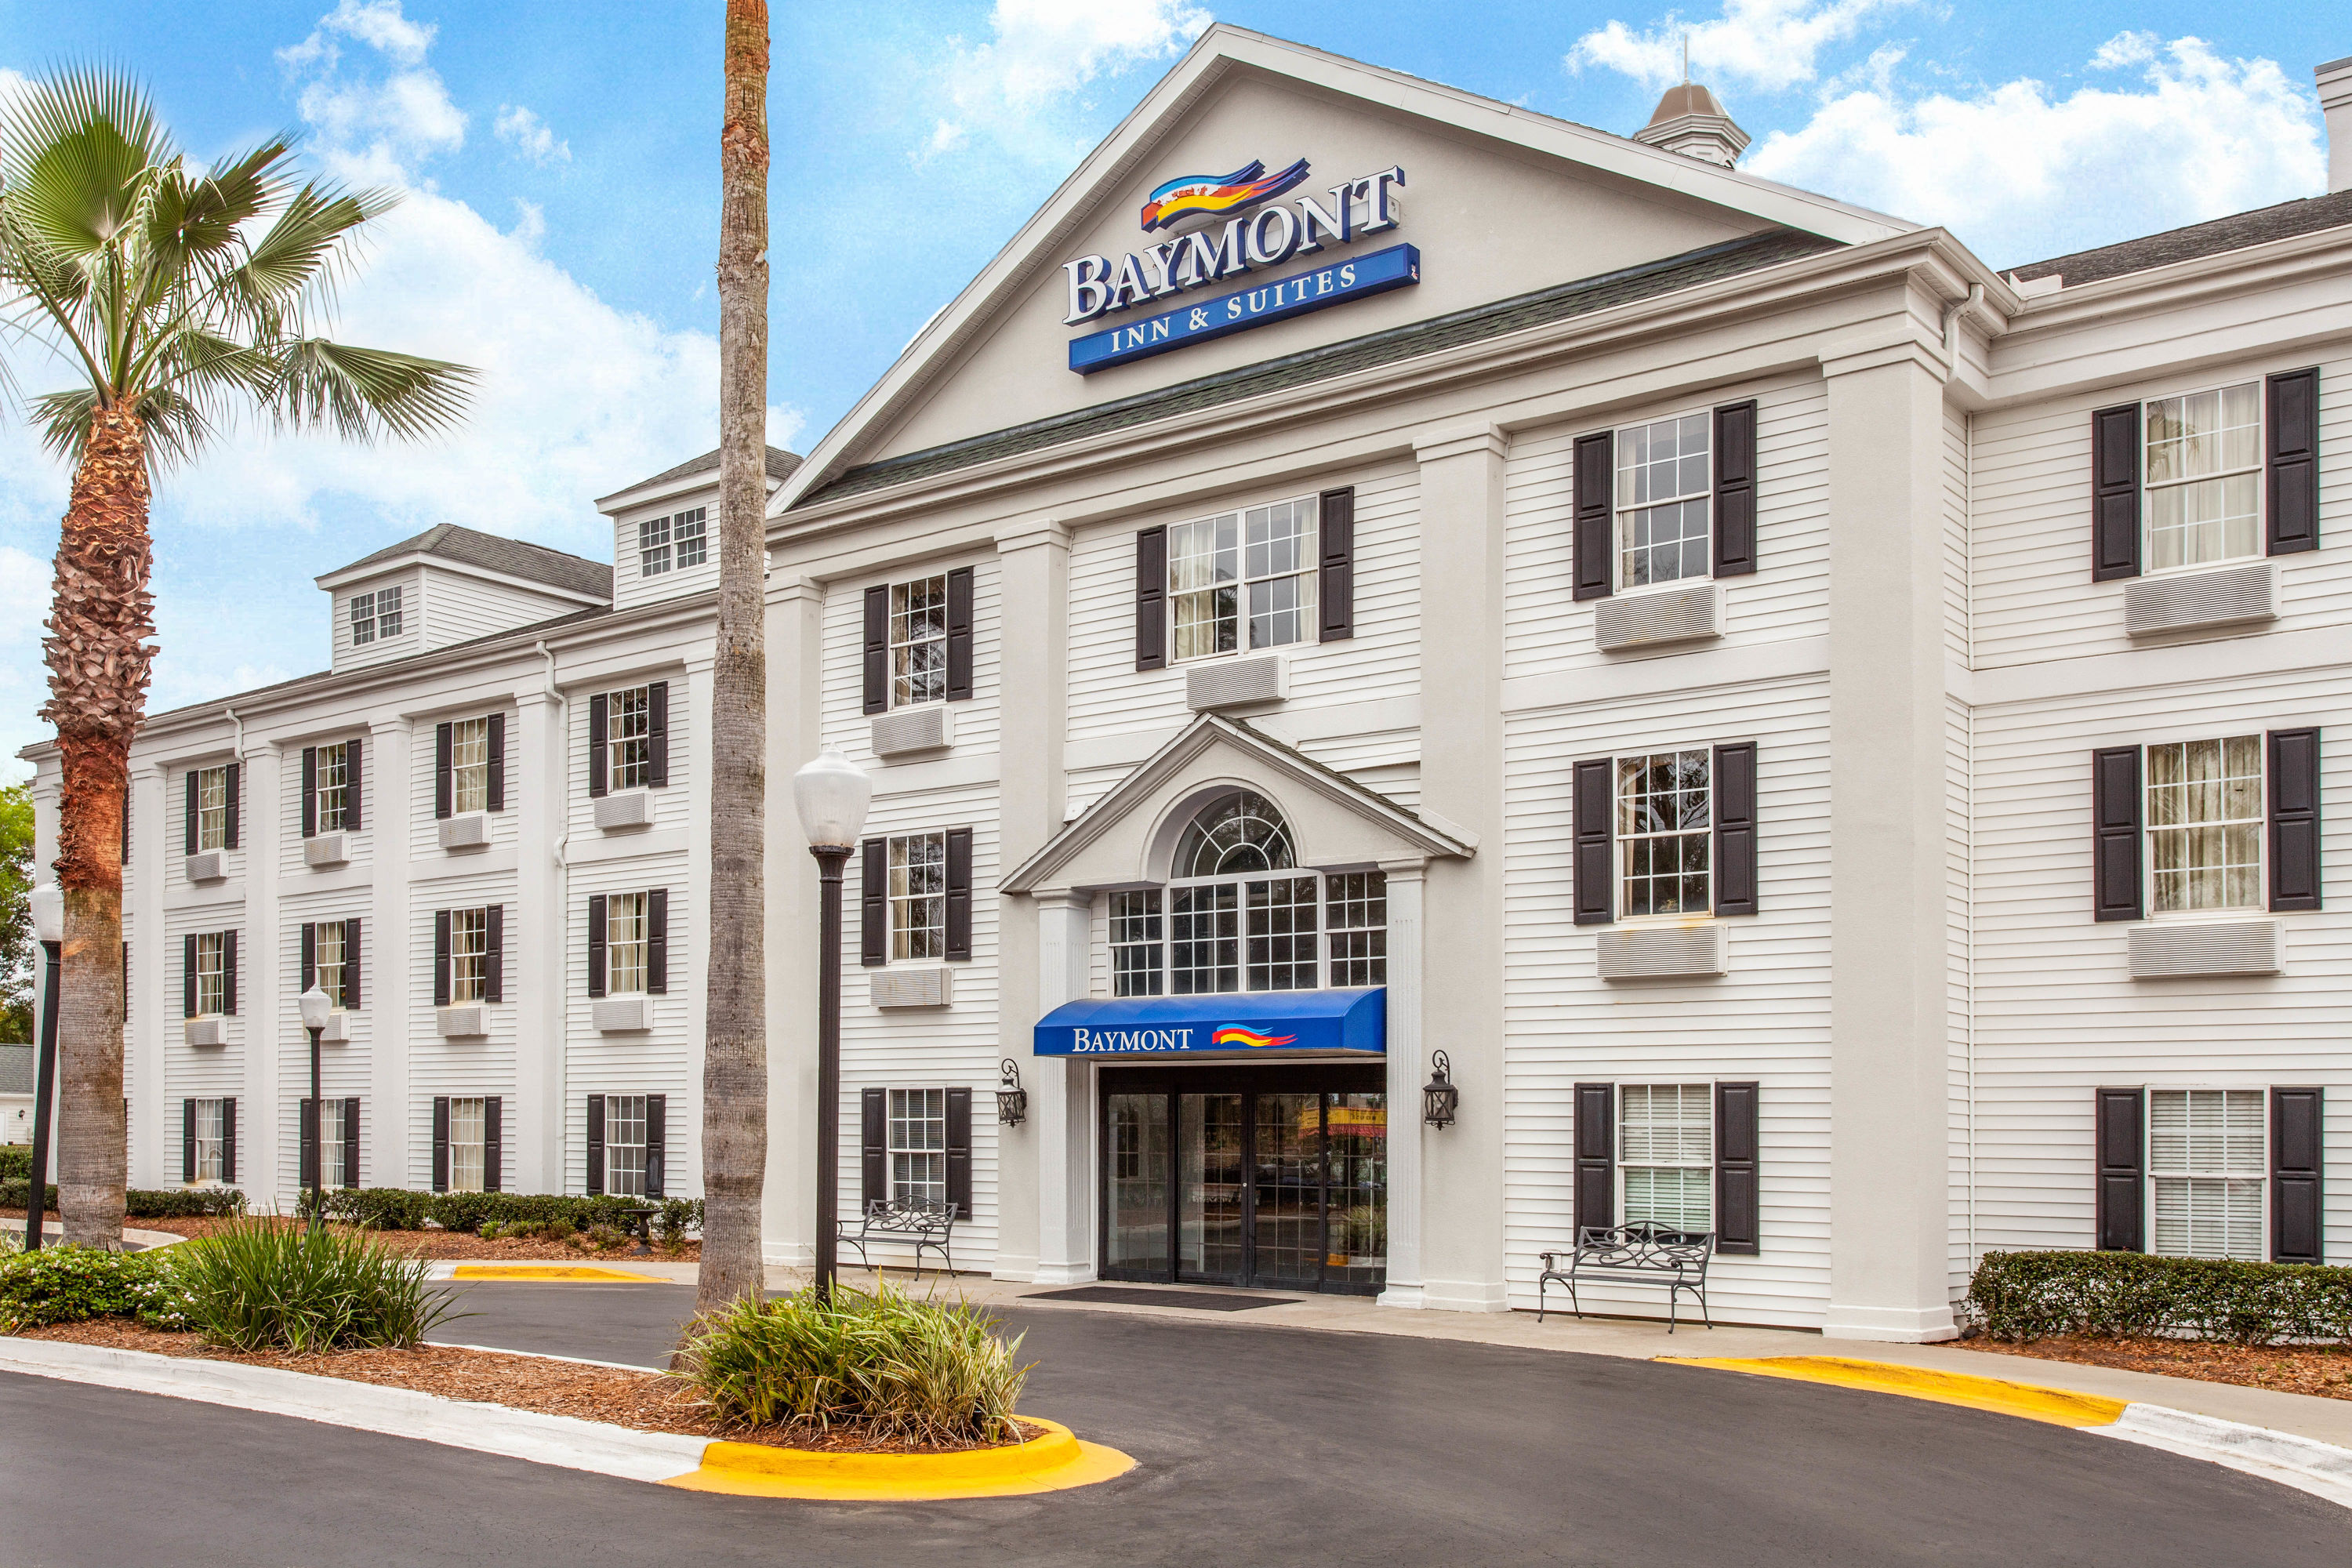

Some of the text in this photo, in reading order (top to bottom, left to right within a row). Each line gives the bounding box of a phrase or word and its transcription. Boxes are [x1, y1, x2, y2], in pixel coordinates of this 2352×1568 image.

[1062, 165, 1403, 326] BAYMONT
[1111, 264, 1356, 353] INN & SUITES
[1072, 1028, 1193, 1052] BAYMONT
